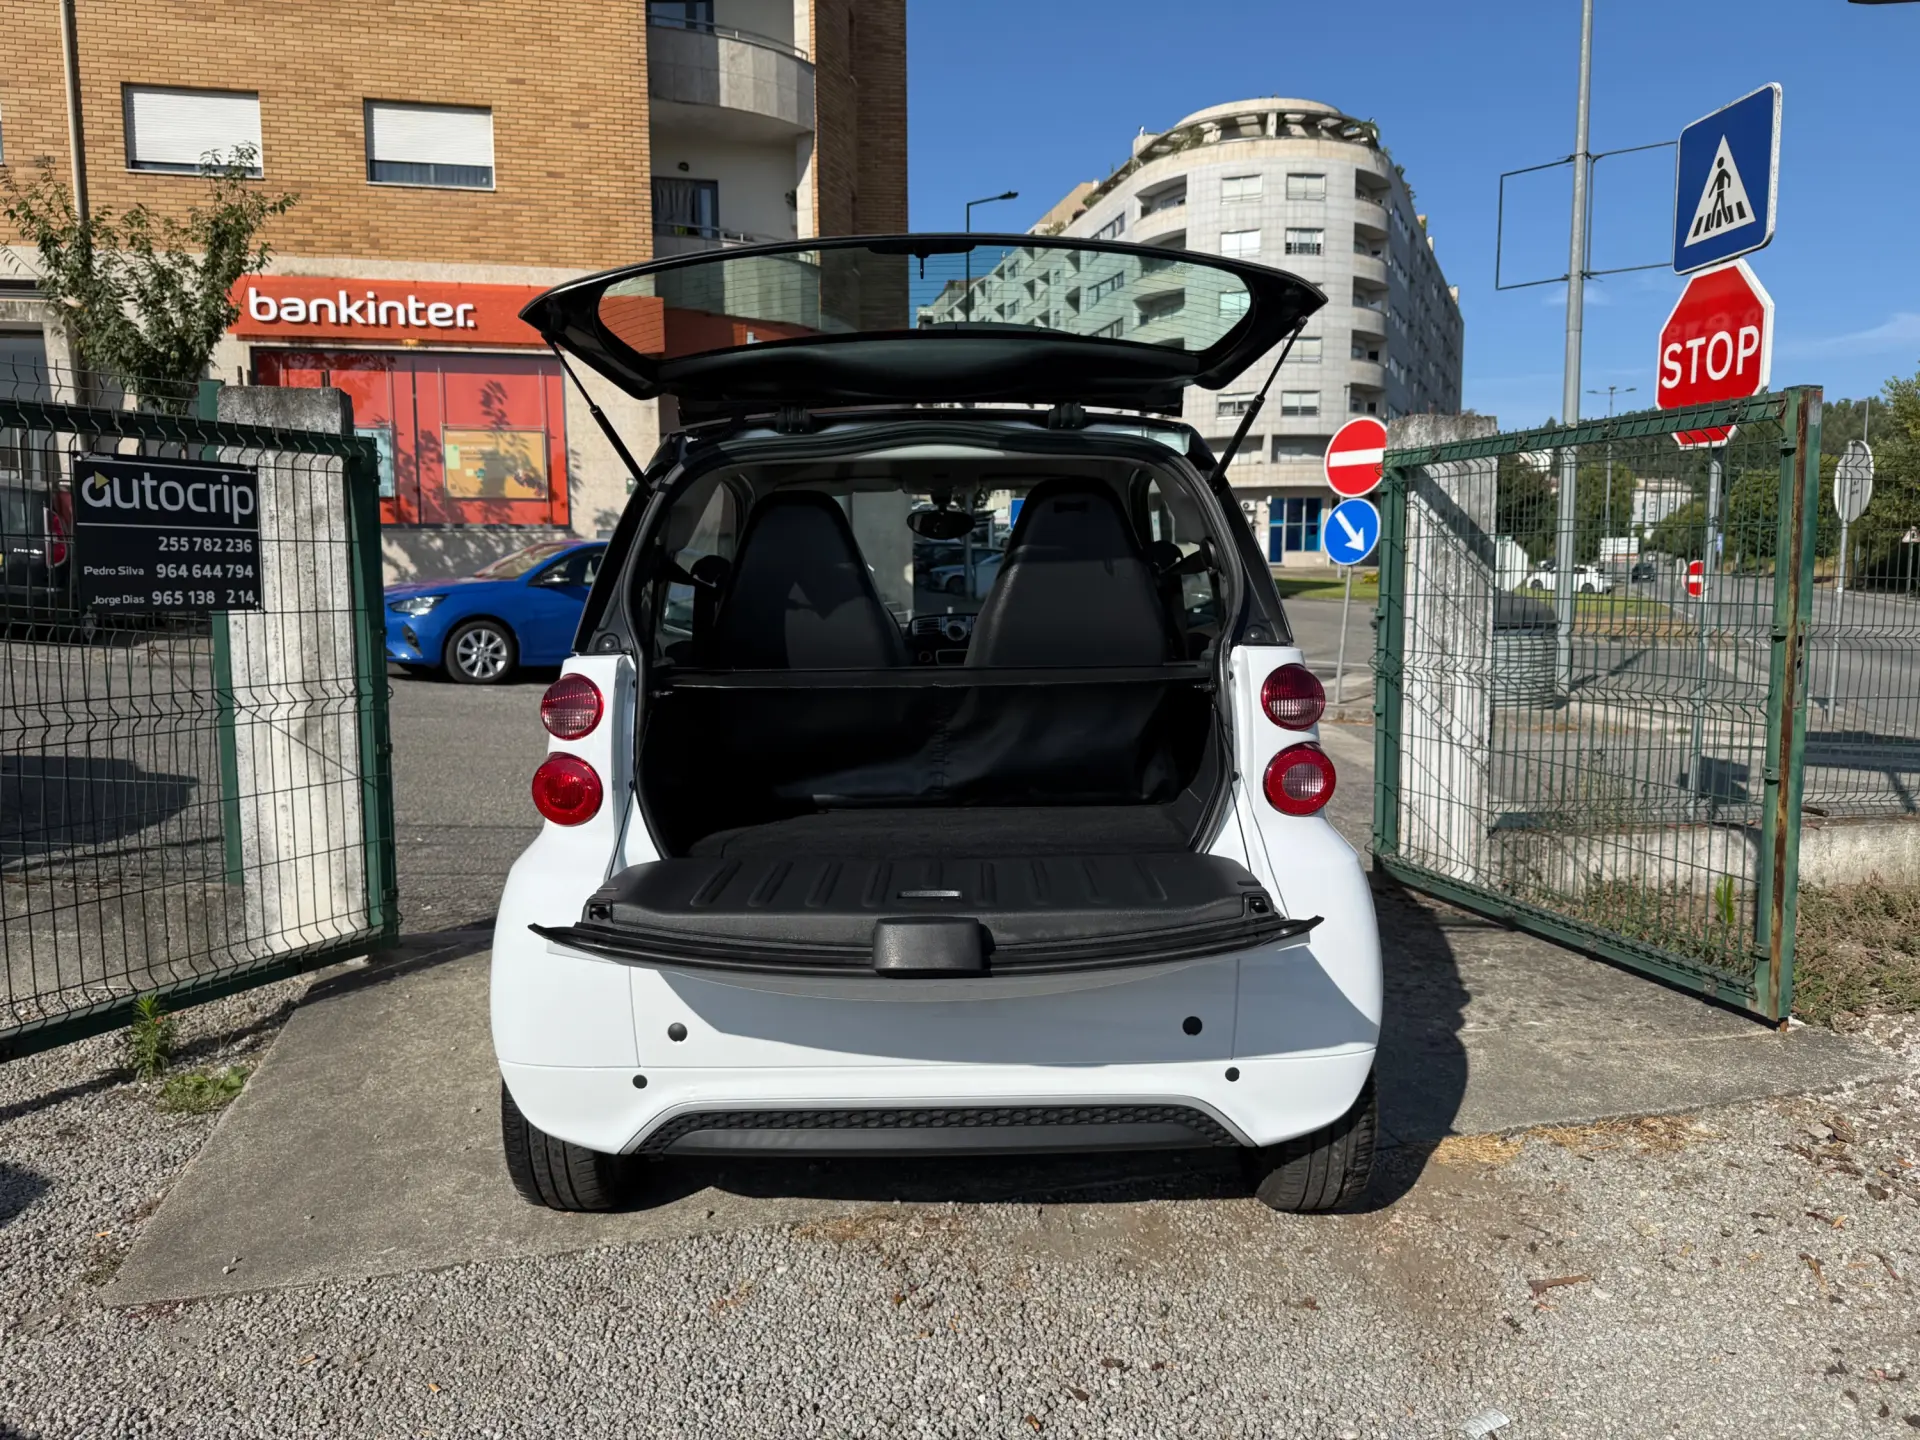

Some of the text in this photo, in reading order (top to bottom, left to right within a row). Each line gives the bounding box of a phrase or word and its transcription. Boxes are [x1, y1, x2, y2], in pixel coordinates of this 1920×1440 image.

[1661, 325, 1760, 389] STOP
[82, 471, 254, 524] autocrip
[158, 536, 252, 553] 255 782 236
[84, 566, 145, 576] Pedro Silva
[156, 564, 254, 578] 964 644 794
[92, 595, 145, 606] Jorge Dias
[152, 590, 255, 605] 965 138 214
